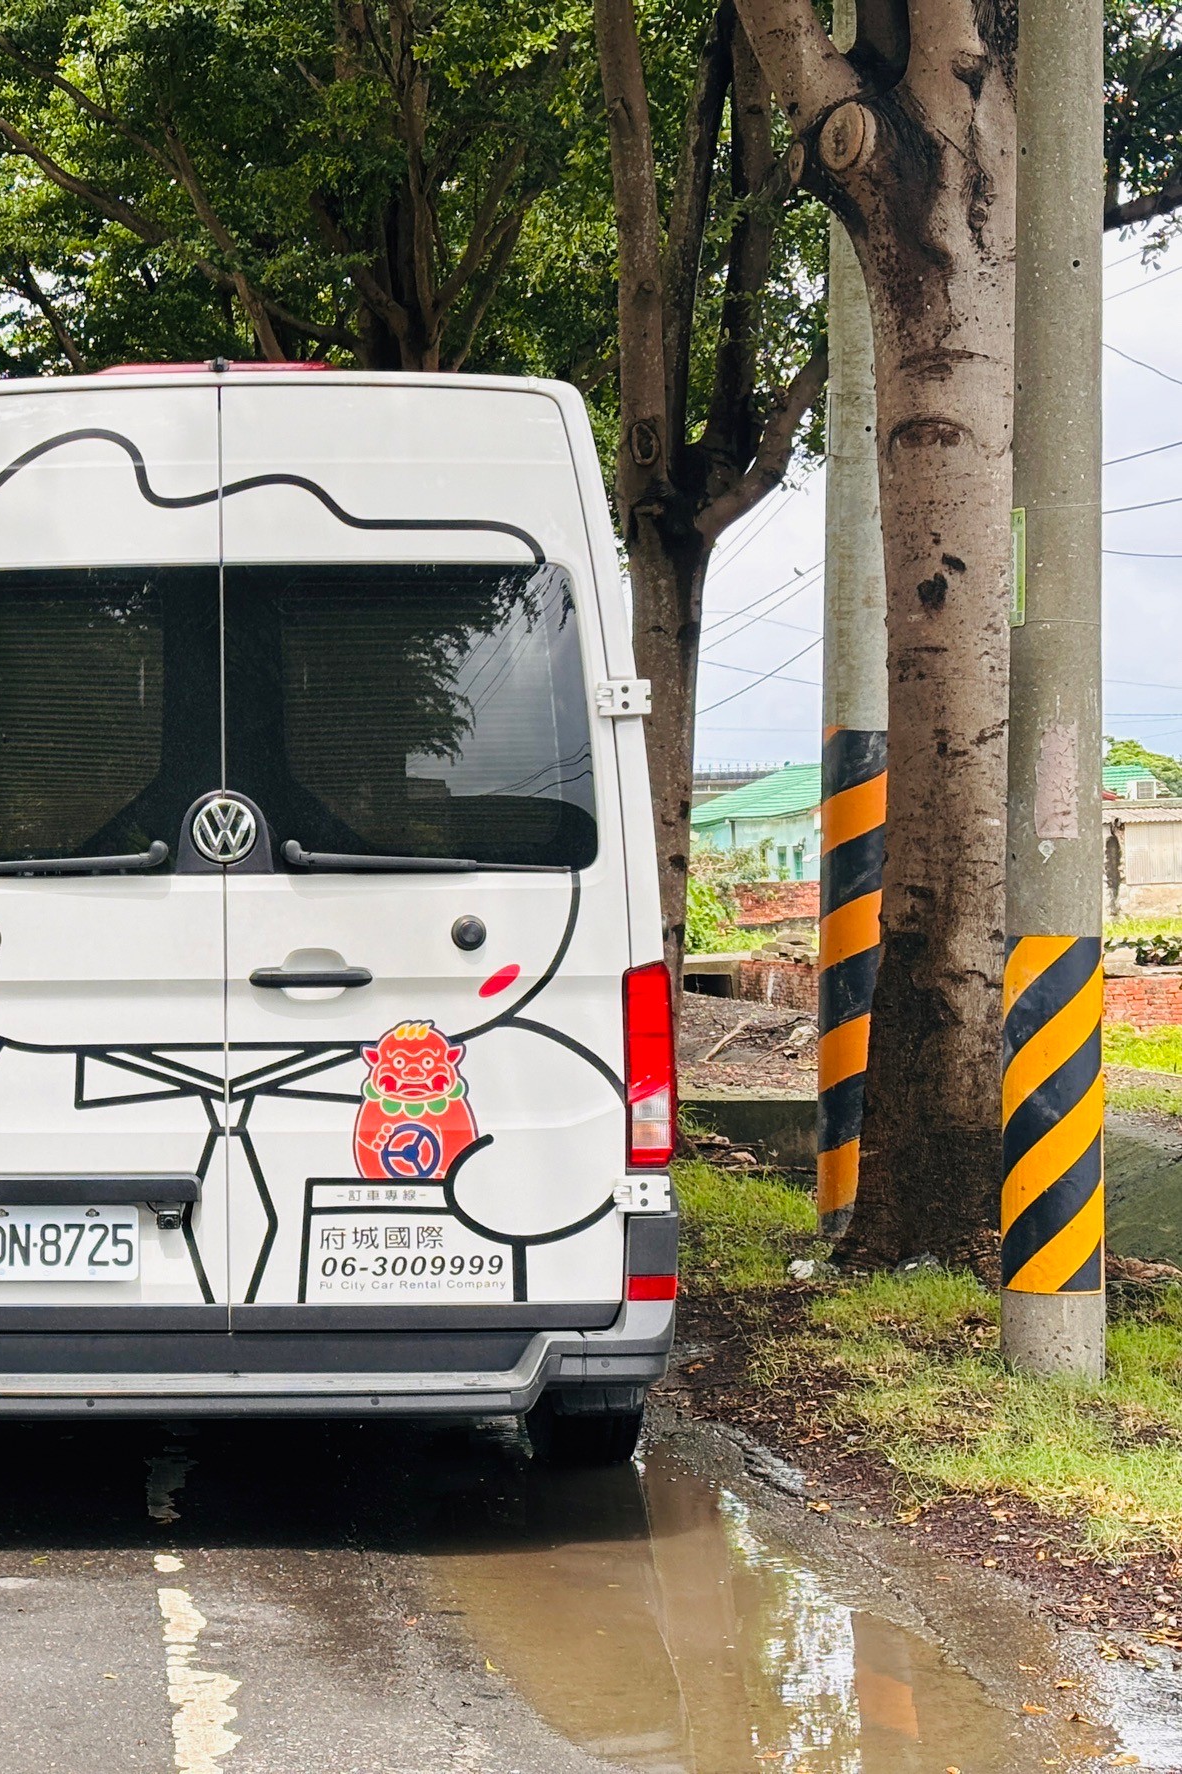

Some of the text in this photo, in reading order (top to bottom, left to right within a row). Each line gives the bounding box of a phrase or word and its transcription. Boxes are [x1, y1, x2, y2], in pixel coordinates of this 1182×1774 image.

[320, 1226, 444, 1250] 府城國際
[321, 1255, 504, 1277] 06-3009999
[340, 1281, 366, 1291] City
[371, 1281, 394, 1290] Car
[399, 1280, 441, 1290] Rental
[446, 1280, 506, 1290] Company
